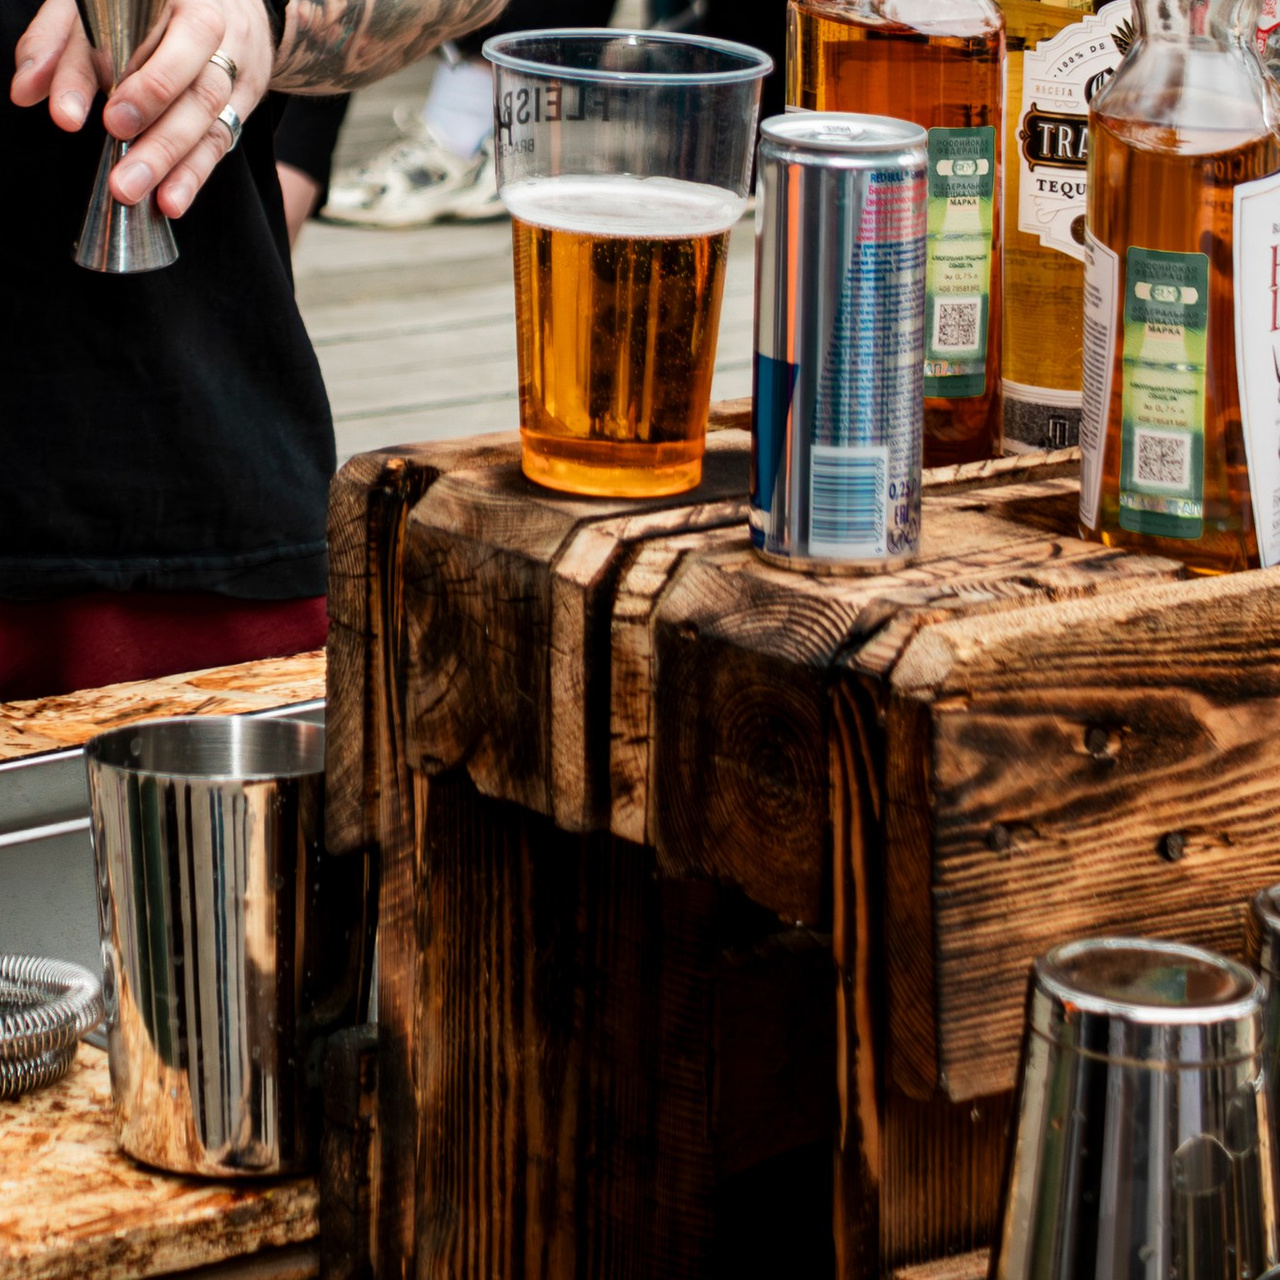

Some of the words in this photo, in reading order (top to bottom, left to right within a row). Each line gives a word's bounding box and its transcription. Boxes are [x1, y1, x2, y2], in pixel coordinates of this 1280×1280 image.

[1057, 51, 1084, 74] 100%
[1090, 42, 1106, 54] DE
[1035, 84, 1073, 97] RECETA
[1148, 324, 1181, 336] МАРКА
